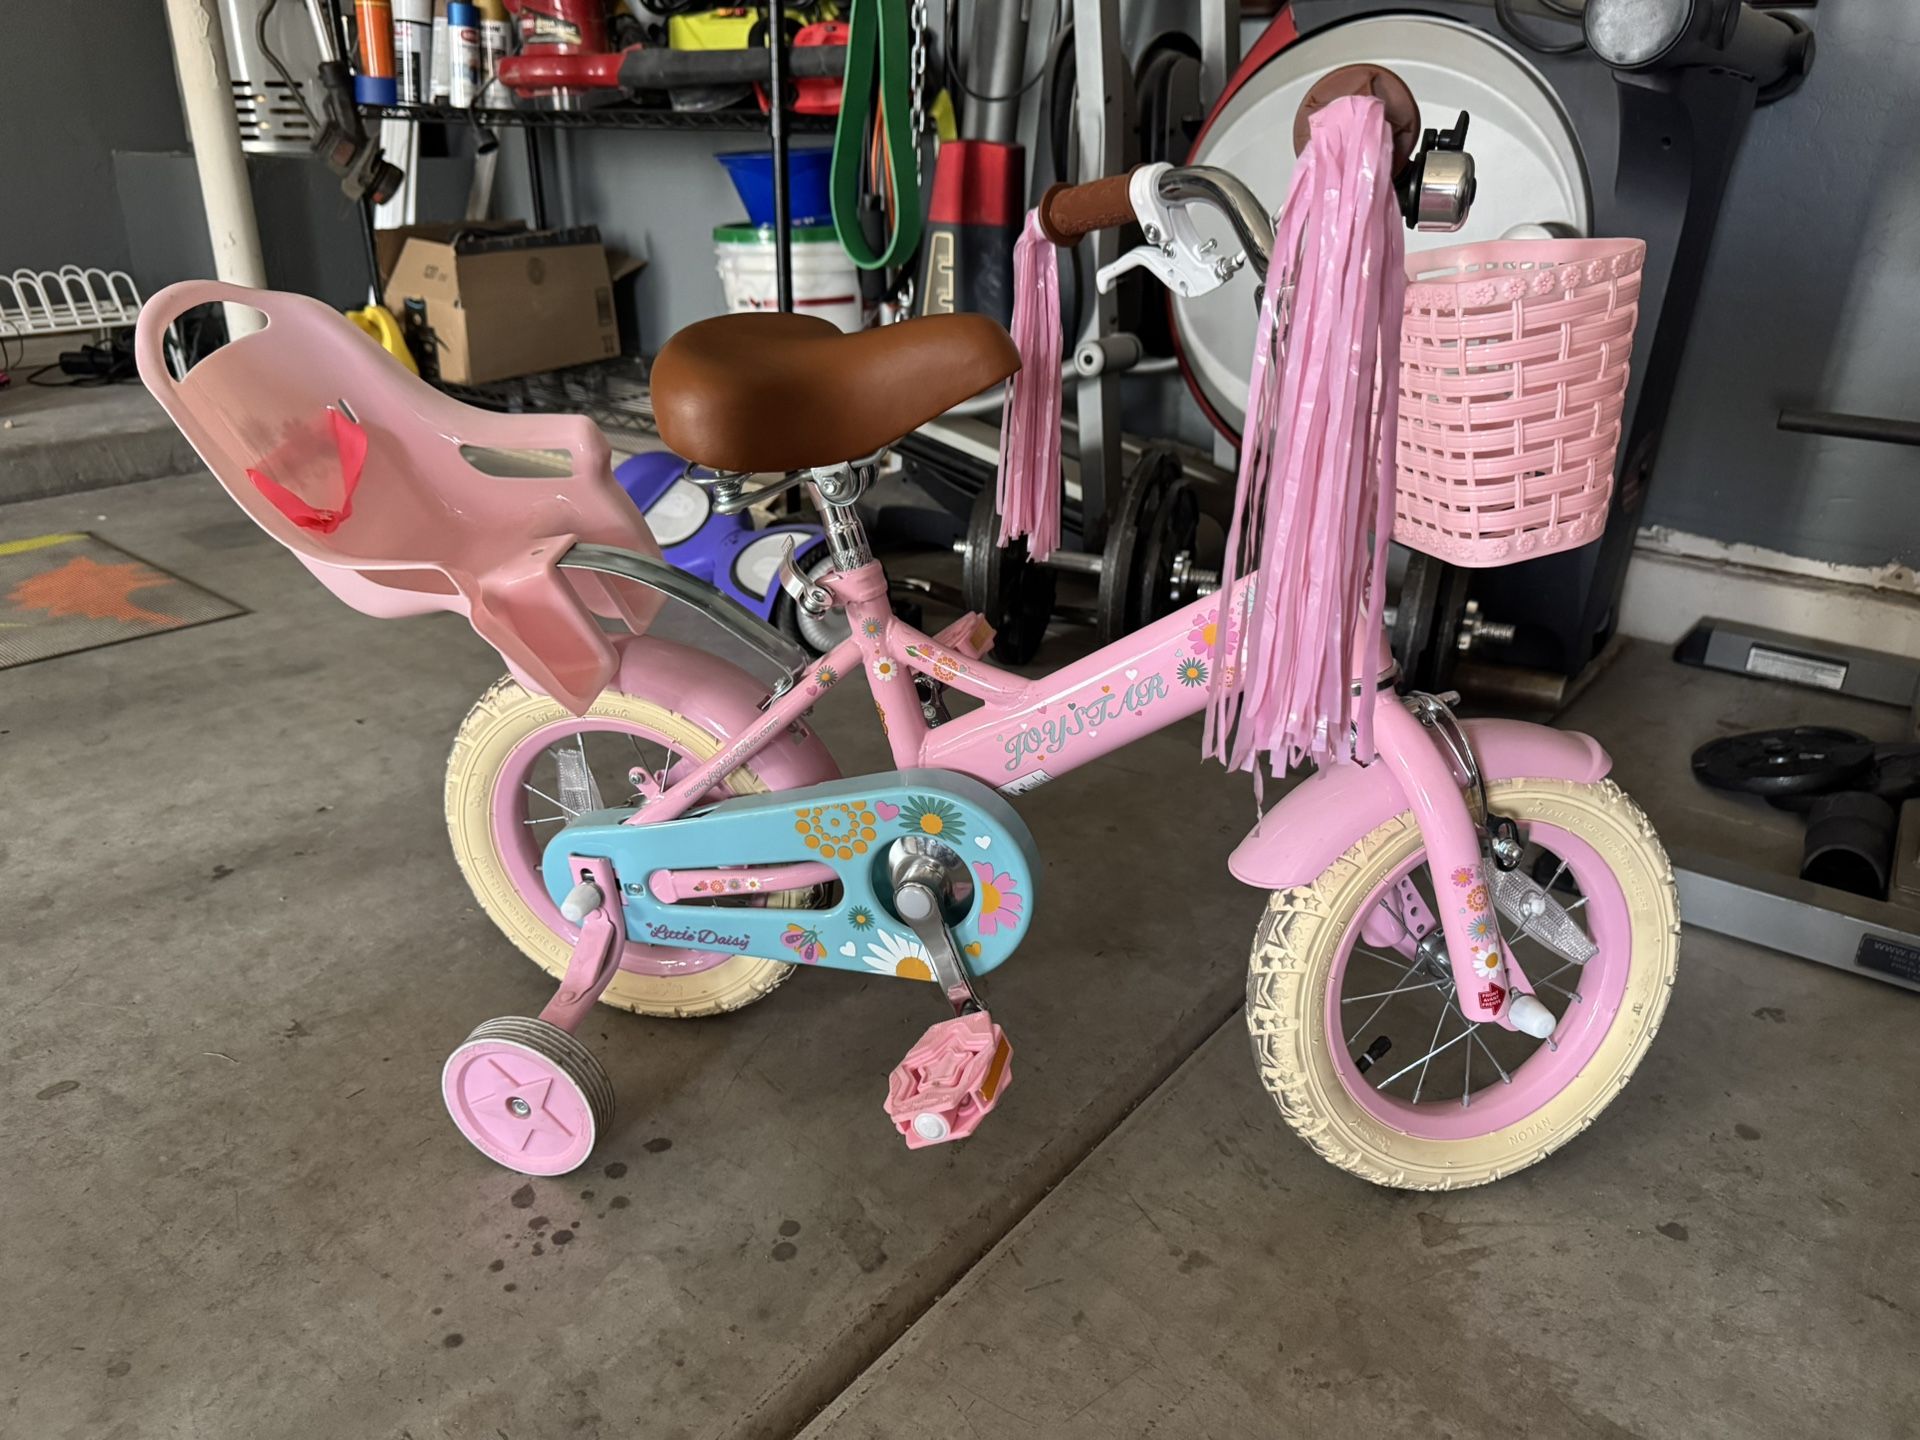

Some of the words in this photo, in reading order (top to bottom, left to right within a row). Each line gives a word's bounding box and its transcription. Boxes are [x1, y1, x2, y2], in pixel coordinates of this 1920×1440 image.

[1004, 672, 1169, 772] JOYSTAR
[650, 924, 696, 942] Little
[698, 929, 751, 951] Daisy
[1482, 990, 1499, 998] FRONT
[1483, 995, 1499, 1003] AVANT
[1481, 999, 1502, 1007] FRENTE
[1507, 1117, 1551, 1146] NYLON
